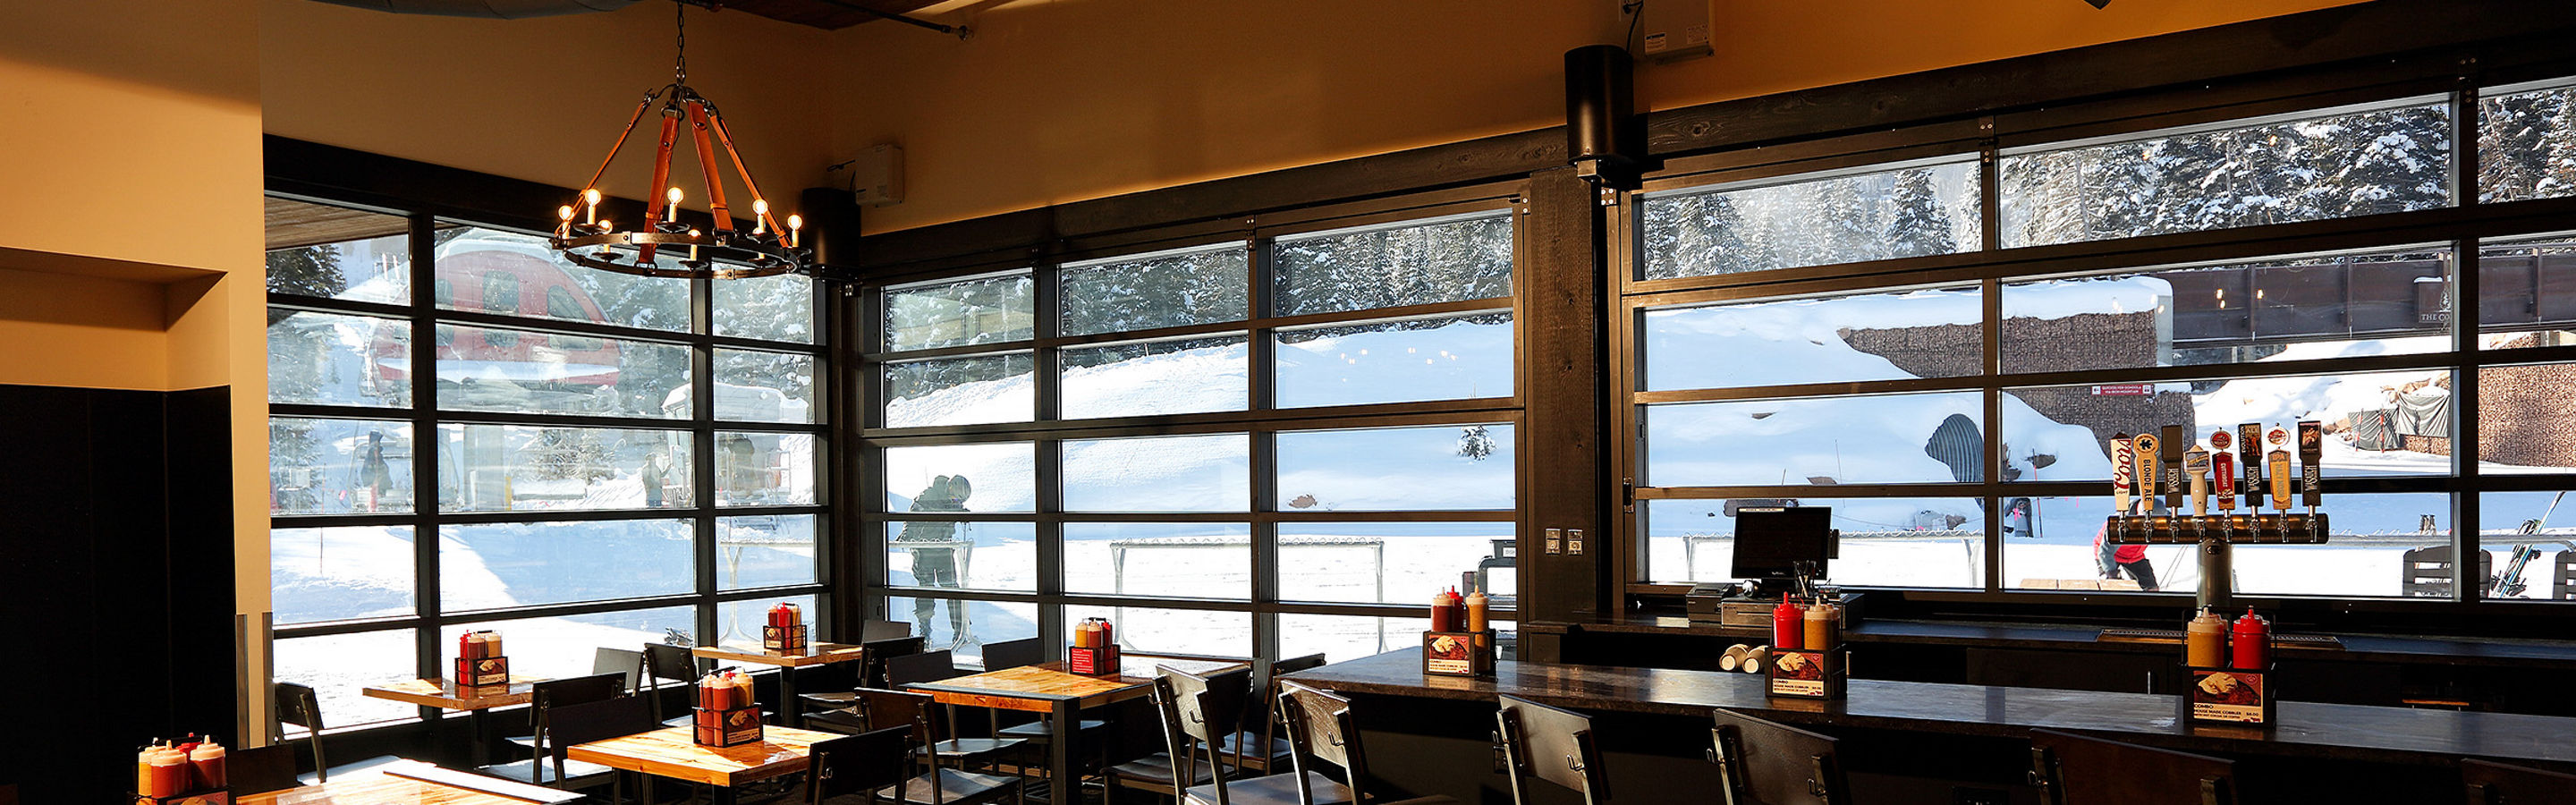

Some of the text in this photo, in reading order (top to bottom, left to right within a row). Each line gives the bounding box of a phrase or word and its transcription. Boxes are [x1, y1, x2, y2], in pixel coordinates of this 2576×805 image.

[2438, 313, 2450, 321] CO
[2114, 439, 2131, 489] Coors
[2143, 459, 2152, 487] BLONDE
[2167, 468, 2180, 494] WASATCH
[2246, 466, 2260, 493] WASATCH
[2304, 465, 2318, 491] WASATCH
[2144, 488, 2153, 502] ALE
